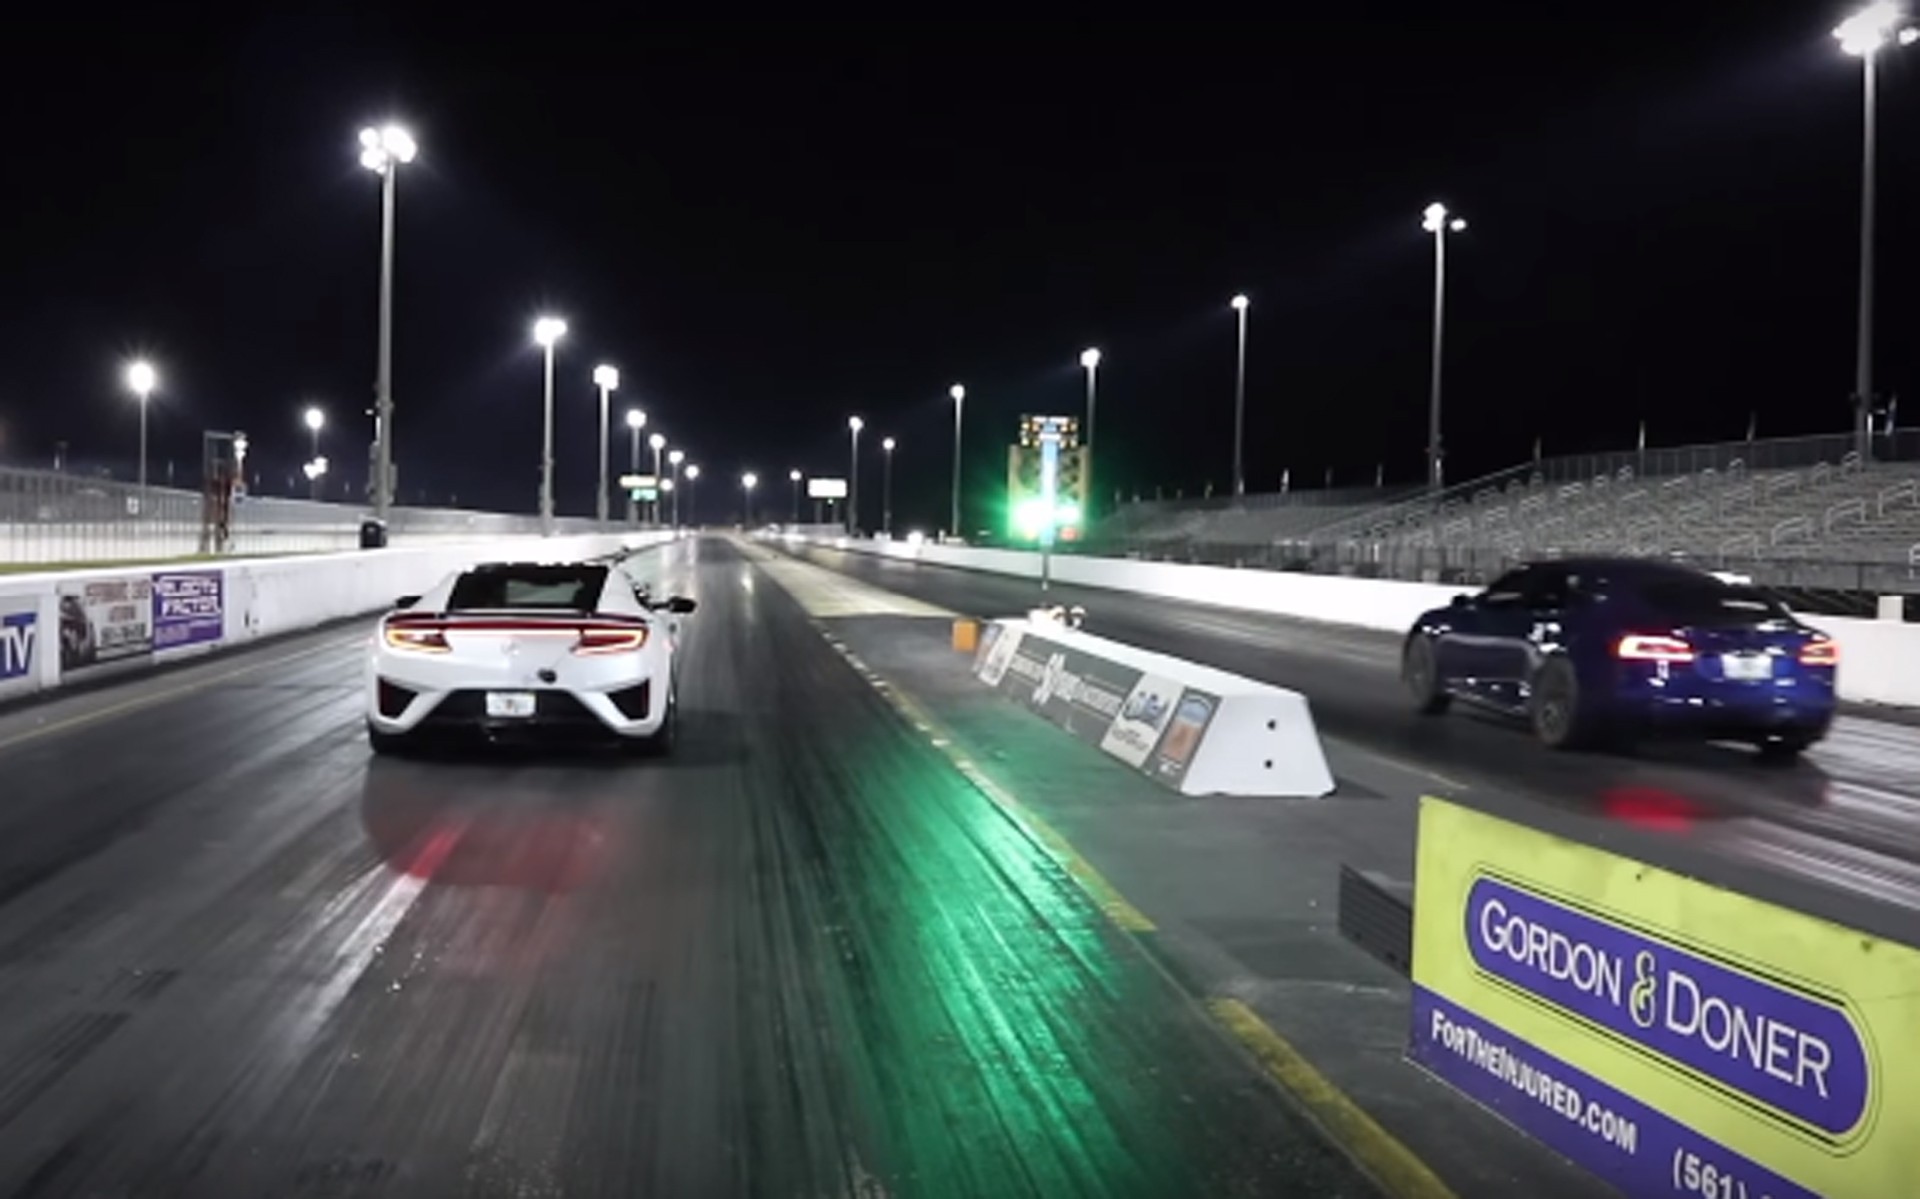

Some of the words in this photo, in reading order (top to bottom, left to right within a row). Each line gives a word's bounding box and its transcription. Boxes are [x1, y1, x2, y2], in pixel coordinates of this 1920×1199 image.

[1480, 899, 1623, 1006] GORDON
[1628, 950, 1657, 1028] &
[1666, 972, 1832, 1097] DONER
